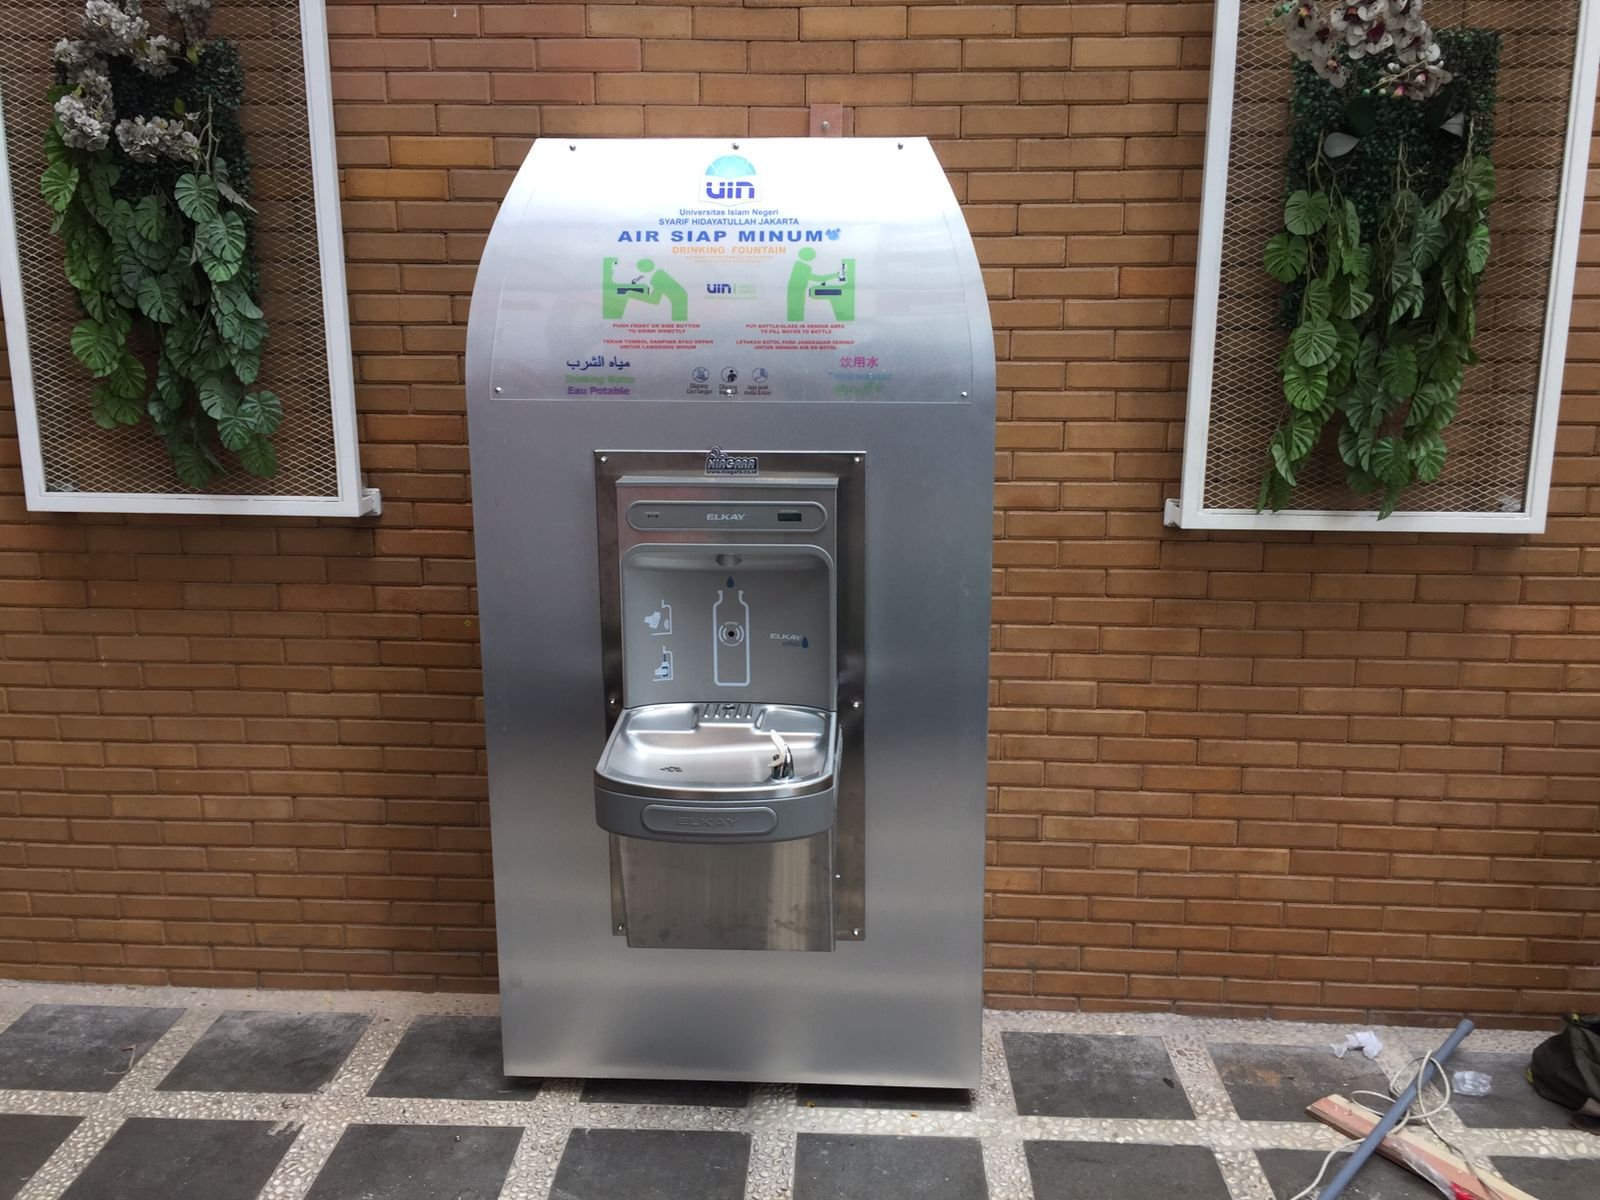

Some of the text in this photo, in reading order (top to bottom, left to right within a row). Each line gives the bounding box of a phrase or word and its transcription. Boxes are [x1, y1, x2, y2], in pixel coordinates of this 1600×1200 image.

[679, 208, 779, 217] Universitas Islam Negeri
[617, 230, 823, 242] AIR SIAP MINUM
[672, 246, 786, 254] DRINKING FOUNTAIN
[566, 355, 631, 371] مياه الشرب
[840, 356, 879, 369] 饮用水
[567, 386, 631, 395] Eau Potable
[706, 513, 747, 521] ELKAY
[769, 632, 802, 640] ELKAY
[678, 816, 738, 826] ELKAY
